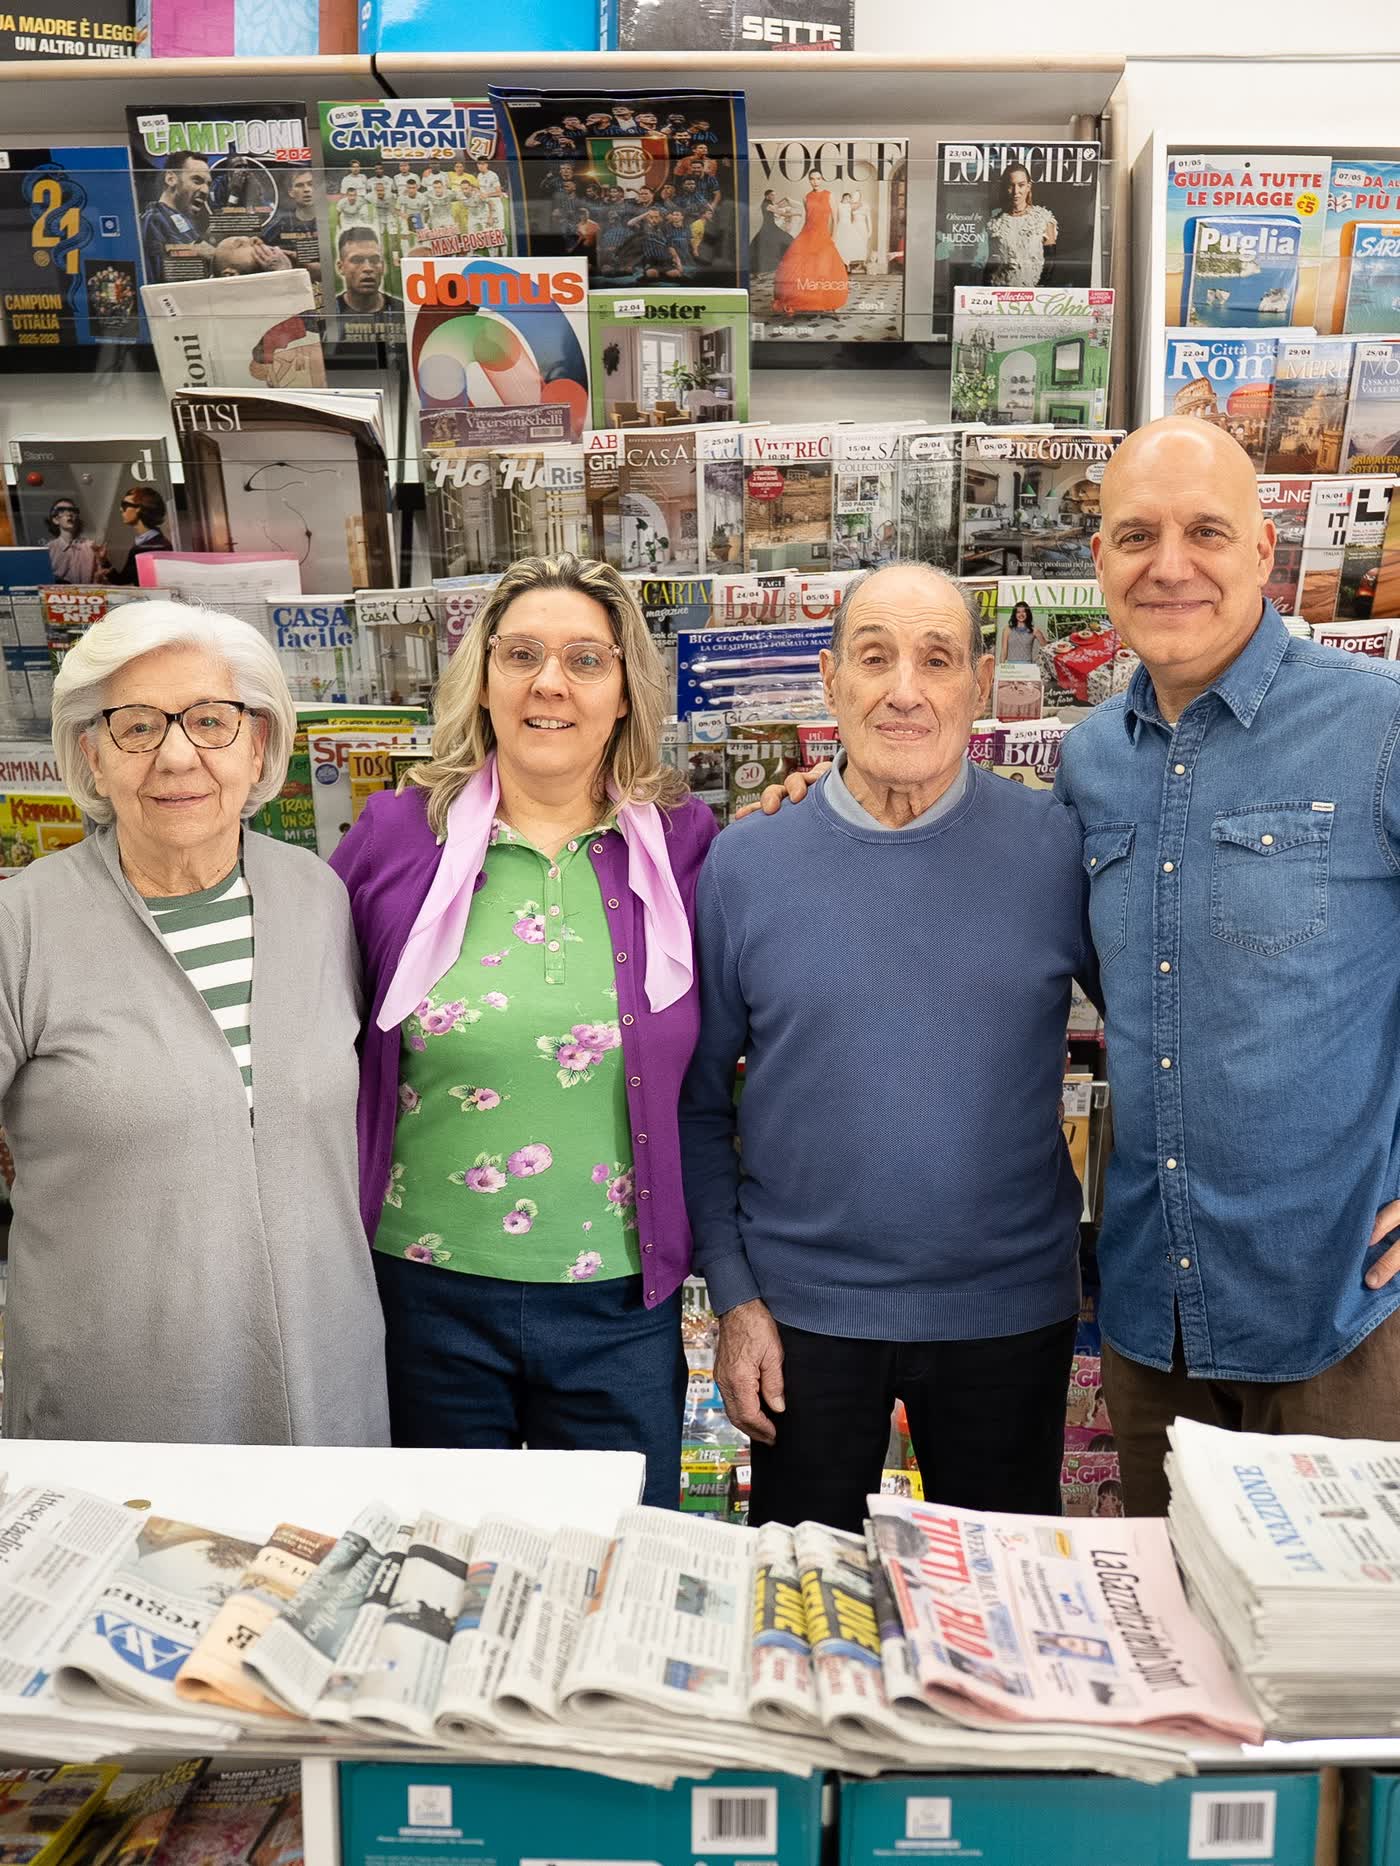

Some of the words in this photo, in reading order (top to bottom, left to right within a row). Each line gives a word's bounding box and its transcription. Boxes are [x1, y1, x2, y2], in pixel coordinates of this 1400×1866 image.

[19, 16, 77, 37] MADRE
[80, 18, 90, 38] È
[742, 15, 841, 48] SETTE
[15, 36, 36, 51] UN
[39, 39, 85, 56] ALTRO
[330, 107, 496, 133] RAZIE
[331, 129, 466, 150] CAMPIONI
[752, 142, 903, 182] VOGUE
[1174, 172, 1233, 188] GUIDA
[1240, 173, 1254, 188] A
[1260, 173, 1322, 188] TUTTE
[1187, 191, 1207, 206] LE
[1212, 192, 1294, 207] SPIAGGE
[1355, 190, 1390, 210] PIÙ
[952, 223, 976, 233] KATE
[942, 233, 985, 244] HUDSON
[1201, 226, 1296, 261] Puglia
[406, 261, 585, 305] domus
[5, 294, 62, 312] CAMPIONI
[995, 301, 1035, 317] ASA
[1211, 342, 1247, 355] Città
[175, 404, 243, 433] HTSI
[466, 415, 563, 429] Viversani&belli
[131, 449, 157, 482] d
[838, 462, 896, 474] COLLECTION
[48, 594, 104, 604] AUTO
[643, 581, 708, 606] CARTA
[273, 605, 350, 628] CASA
[645, 605, 690, 622] magazine
[276, 626, 354, 648] facile
[688, 633, 712, 644] BIG
[1233, 1465, 1306, 1547] NAZIONE
